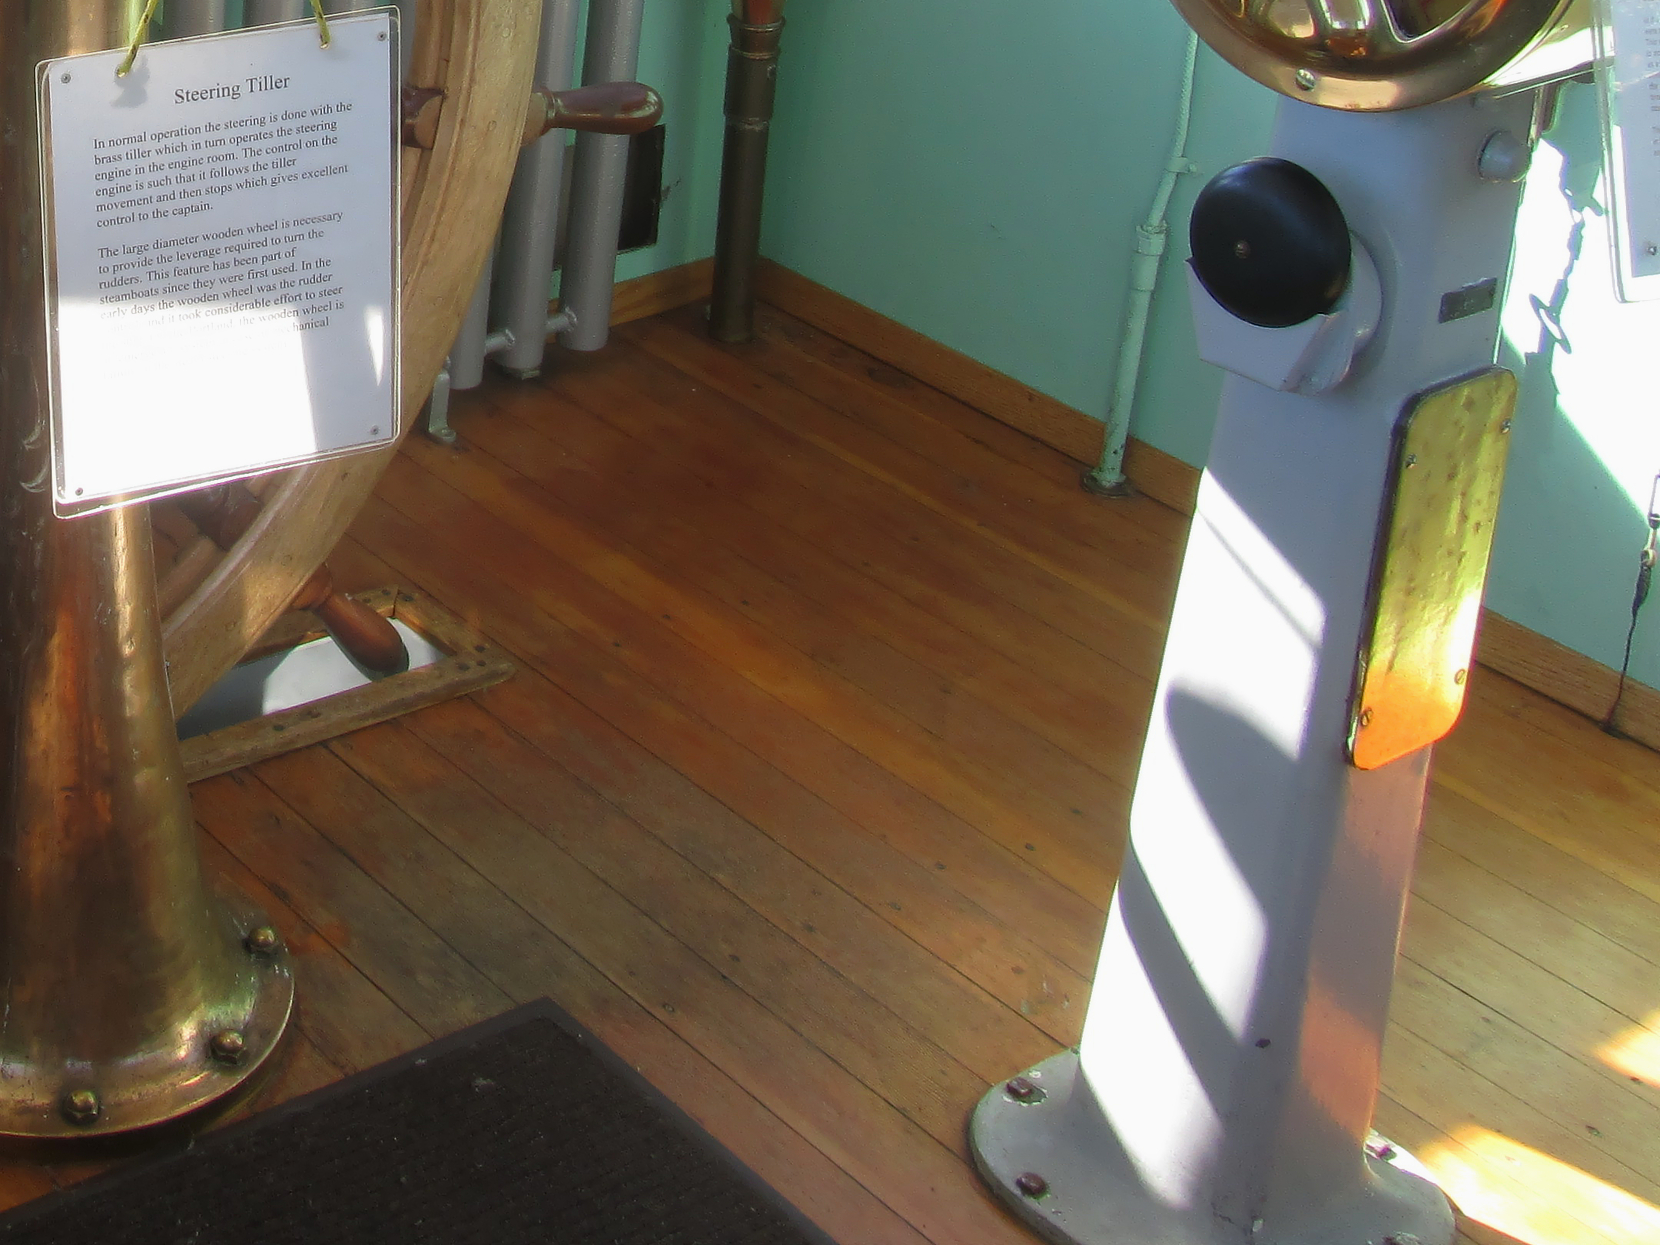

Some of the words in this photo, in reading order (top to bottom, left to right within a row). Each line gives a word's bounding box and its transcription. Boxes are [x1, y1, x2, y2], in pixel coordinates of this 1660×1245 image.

[174, 82, 241, 105] Steering
[245, 75, 291, 93] Tiller
[94, 139, 106, 150] In
[108, 132, 147, 148] normal
[150, 126, 202, 143] operation
[204, 121, 223, 133] the
[223, 116, 266, 130] steering
[269, 113, 280, 123] is
[281, 110, 307, 122] done
[309, 103, 333, 117] with
[335, 101, 352, 113] the
[94, 154, 123, 166] brass
[125, 148, 152, 161] tiller
[155, 141, 189, 156] which
[191, 141, 203, 151] in
[204, 138, 226, 149] turn
[229, 131, 275, 147] operates
[275, 126, 294, 138] the
[295, 121, 338, 135] steering
[94, 168, 131, 182] engine
[133, 165, 145, 176] in
[148, 161, 165, 173] the
[167, 157, 204, 171] engine
[206, 153, 239, 164] room.
[241, 146, 263, 159] The
[265, 139, 302, 155] control
[305, 140, 319, 149] on
[322, 135, 338, 147] the
[95, 184, 134, 198] engine
[135, 181, 144, 191] is
[147, 175, 172, 189] such
[175, 173, 197, 185] that
[199, 171, 207, 181] it
[209, 166, 250, 180] follows
[252, 161, 269, 173] the
[271, 157, 297, 170] tiller
[96, 195, 154, 213] movement
[156, 190, 176, 203] and
[178, 188, 203, 200] then
[204, 184, 233, 196] stops
[235, 175, 268, 191] which
[270, 173, 299, 188] gives
[301, 164, 349, 180] excellent
[97, 212, 135, 228] control
[138, 212, 149, 222] to
[151, 208, 169, 220] the
[172, 201, 214, 217] captain.
[98, 246, 119, 259] The
[122, 244, 150, 256] large
[152, 235, 199, 250] diameter
[202, 227, 243, 242] wooden
[246, 219, 279, 235] wheel
[281, 219, 290, 229] is
[293, 212, 343, 227] necessary
[99, 265, 110, 275] to
[112, 256, 154, 275] provide
[156, 253, 174, 265] the
[176, 247, 221, 262] leverage
[223, 236, 268, 255] required
[271, 237, 281, 246] to
[284, 233, 305, 244] turn
[308, 228, 324, 240] the
[99, 275, 143, 290] rudders.
[146, 269, 170, 282] This
[173, 264, 210, 278] feature
[212, 260, 231, 271] has
[233, 256, 259, 268] been
[261, 251, 282, 266] part
[284, 247, 297, 259] of
[99, 287, 159, 305] steamboats
[162, 283, 190, 295] since
[193, 277, 216, 290] they
[218, 274, 244, 285] were
[247, 268, 269, 281] first
[271, 262, 297, 276] used.
[301, 260, 313, 271] In
[315, 257, 332, 269] the
[130, 304, 155, 316] days
[158, 298, 175, 311] the
[177, 292, 219, 307] wooden
[222, 284, 253, 300] wheel
[256, 283, 277, 294] was
[279, 278, 296, 290] the
[298, 272, 332, 287] rudder
[204, 297, 271, 317] considerable
[273, 292, 302, 306] effort
[305, 291, 317, 301] to
[319, 287, 343, 298] steer
[302, 300, 332, 316] wheel
[335, 300, 344, 310] is
